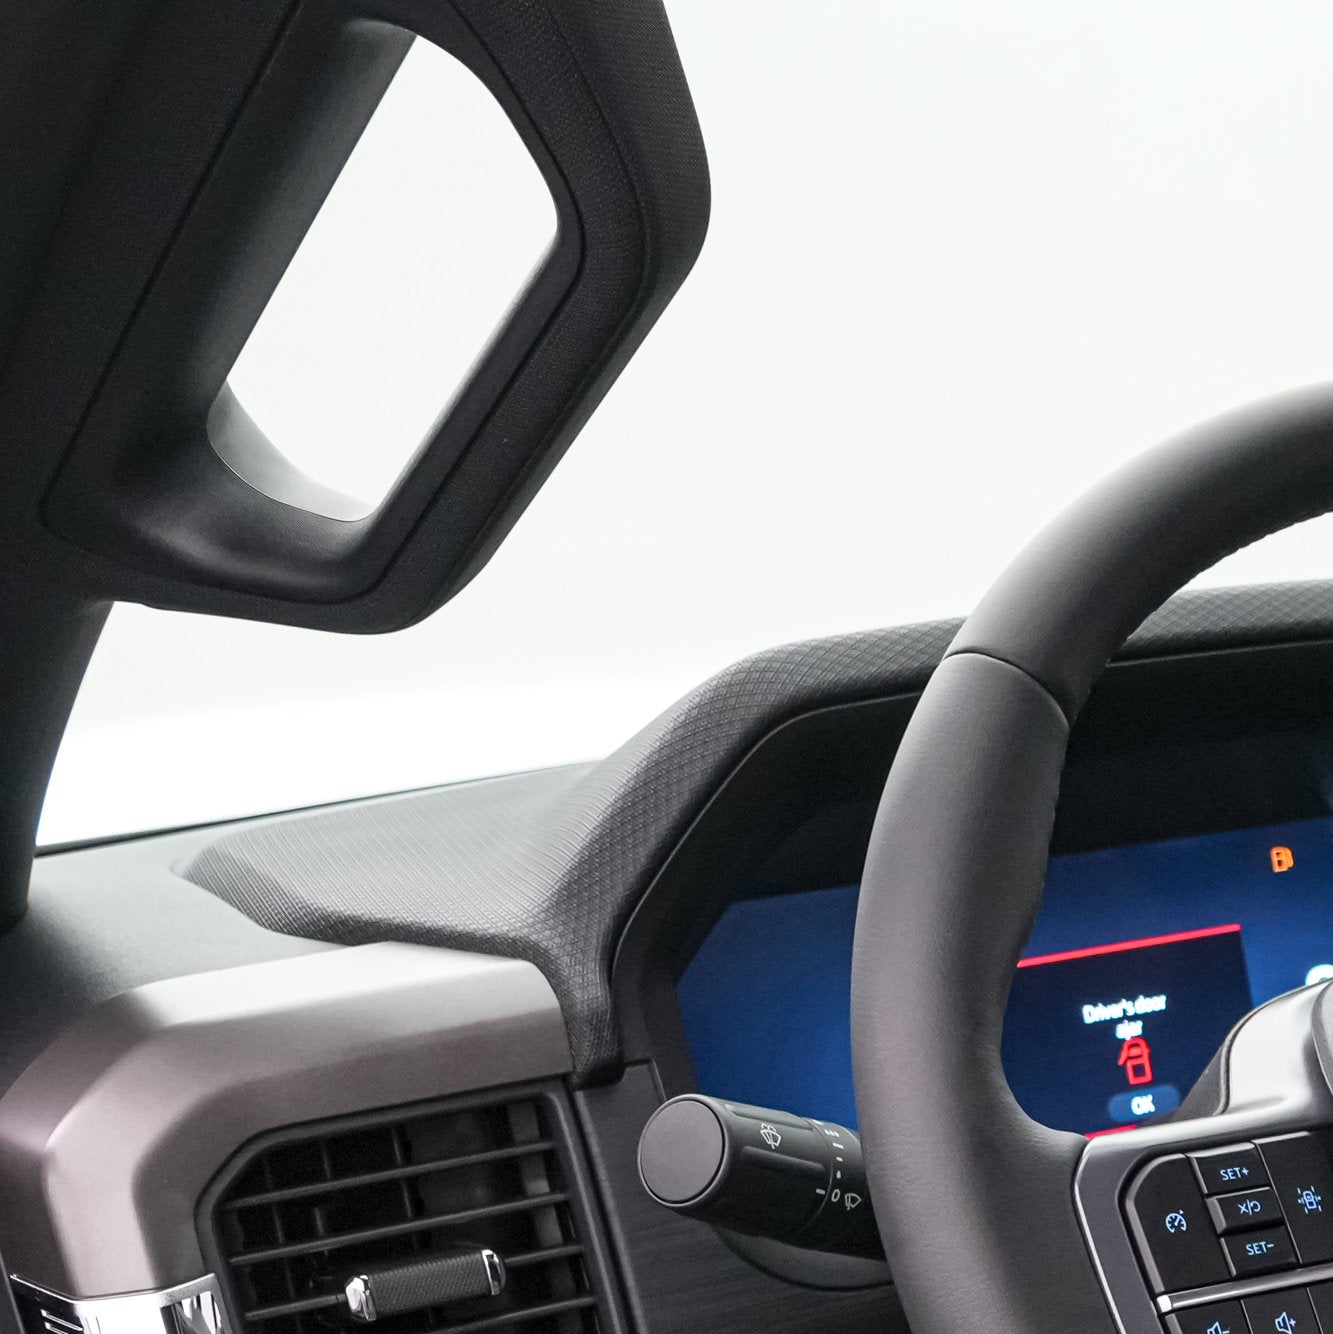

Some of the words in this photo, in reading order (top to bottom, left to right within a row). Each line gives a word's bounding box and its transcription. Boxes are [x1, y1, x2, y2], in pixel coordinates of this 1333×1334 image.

[1082, 999, 1135, 1024] Driver's
[1134, 994, 1167, 1015] door
[1115, 1019, 1144, 1041] ajar
[1131, 1094, 1155, 1116] OK
[1219, 1166, 1250, 1181] SET+
